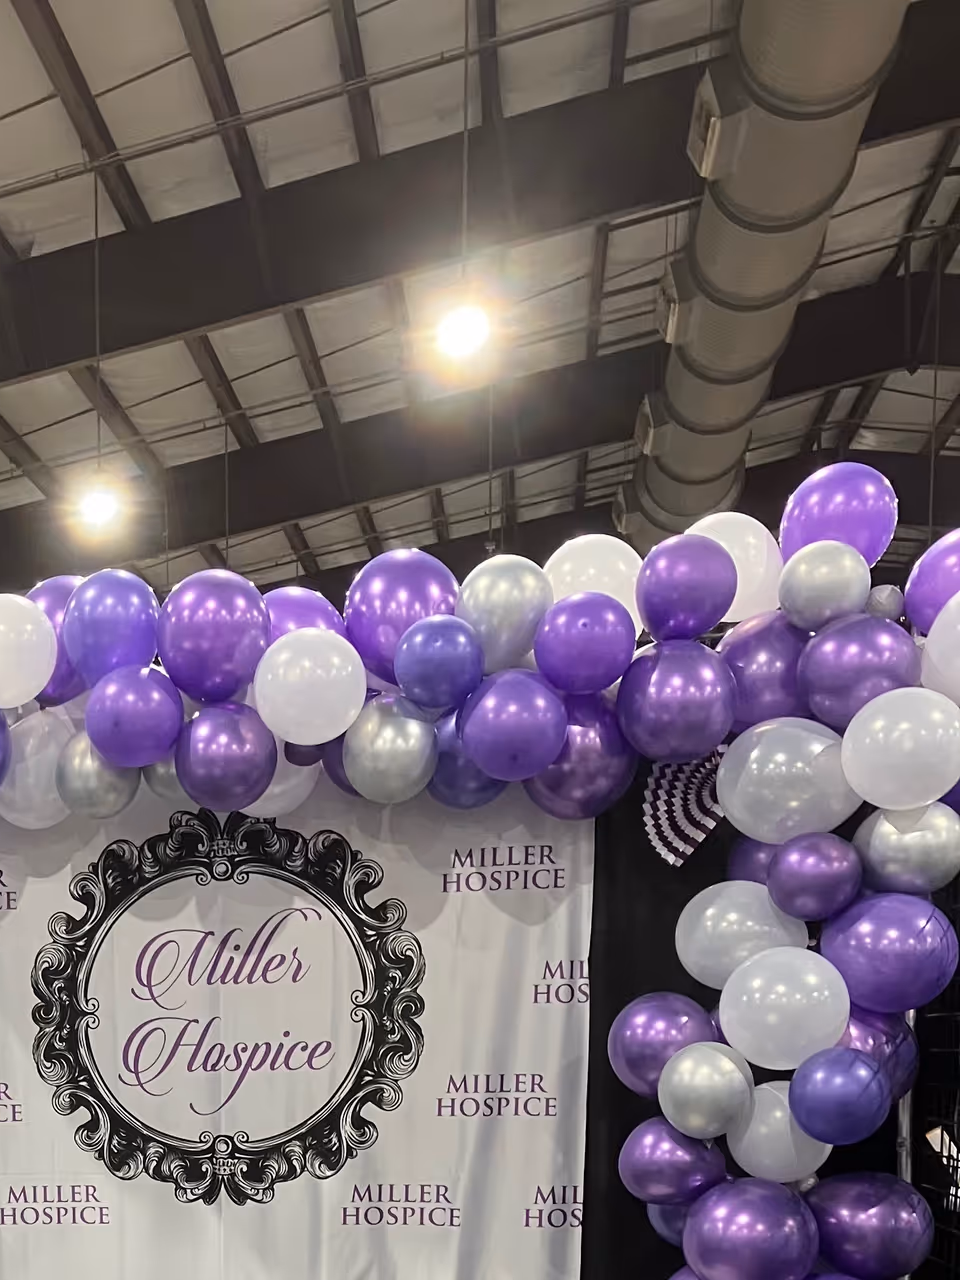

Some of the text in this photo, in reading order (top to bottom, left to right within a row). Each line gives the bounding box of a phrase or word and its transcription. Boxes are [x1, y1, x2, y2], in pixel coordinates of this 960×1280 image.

[451, 845, 556, 867] MILLER
[441, 868, 565, 893] HOSPICE
[131, 907, 322, 1011] Miller
[118, 1016, 336, 1115] Hospice
[446, 1073, 548, 1094] MILLER
[436, 1097, 558, 1118] HOSPICE
[7, 1184, 100, 1204] MILLER
[350, 1183, 454, 1204] MILLER
[0, 1205, 111, 1226] HOSPICE
[341, 1206, 461, 1228] HOSPICE
